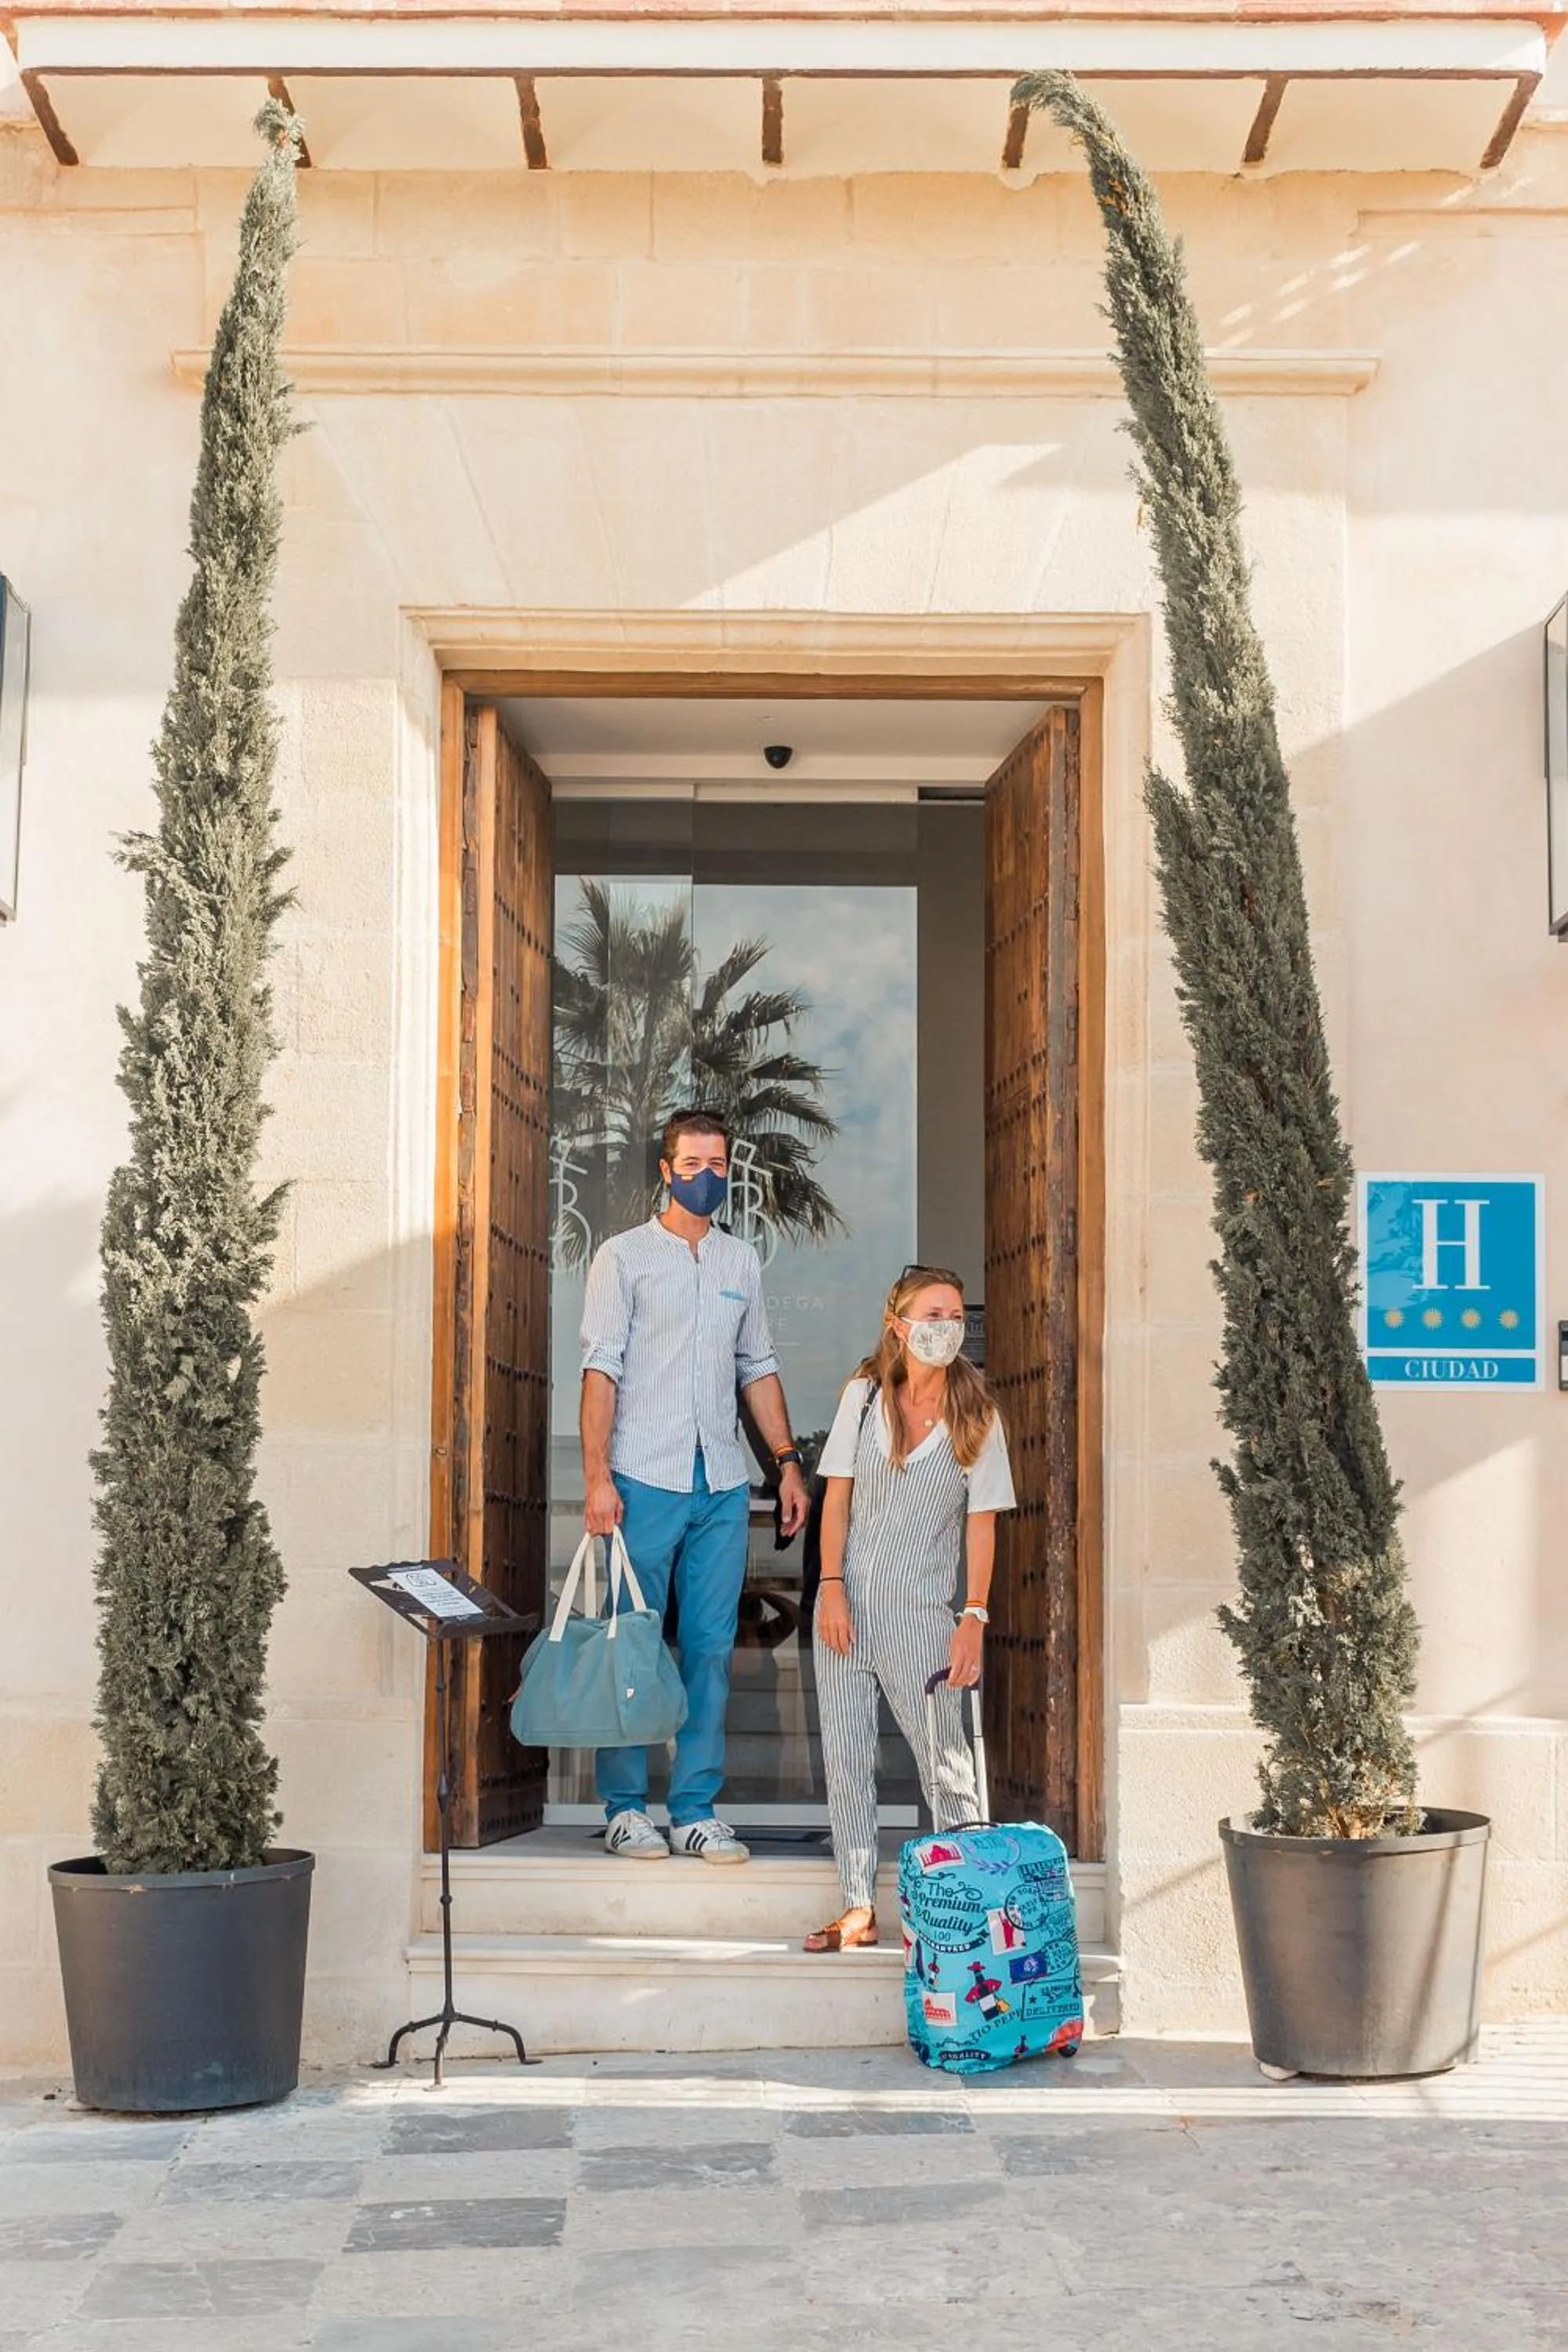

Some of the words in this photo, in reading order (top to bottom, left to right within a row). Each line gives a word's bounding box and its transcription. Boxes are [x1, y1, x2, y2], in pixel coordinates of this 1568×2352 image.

[1411, 1199, 1491, 1290] H
[1404, 1359, 1499, 1380] CIUDAD
[927, 1882, 955, 1897] The
[919, 1891, 982, 1914] Premium
[918, 1909, 977, 1936] Quality
